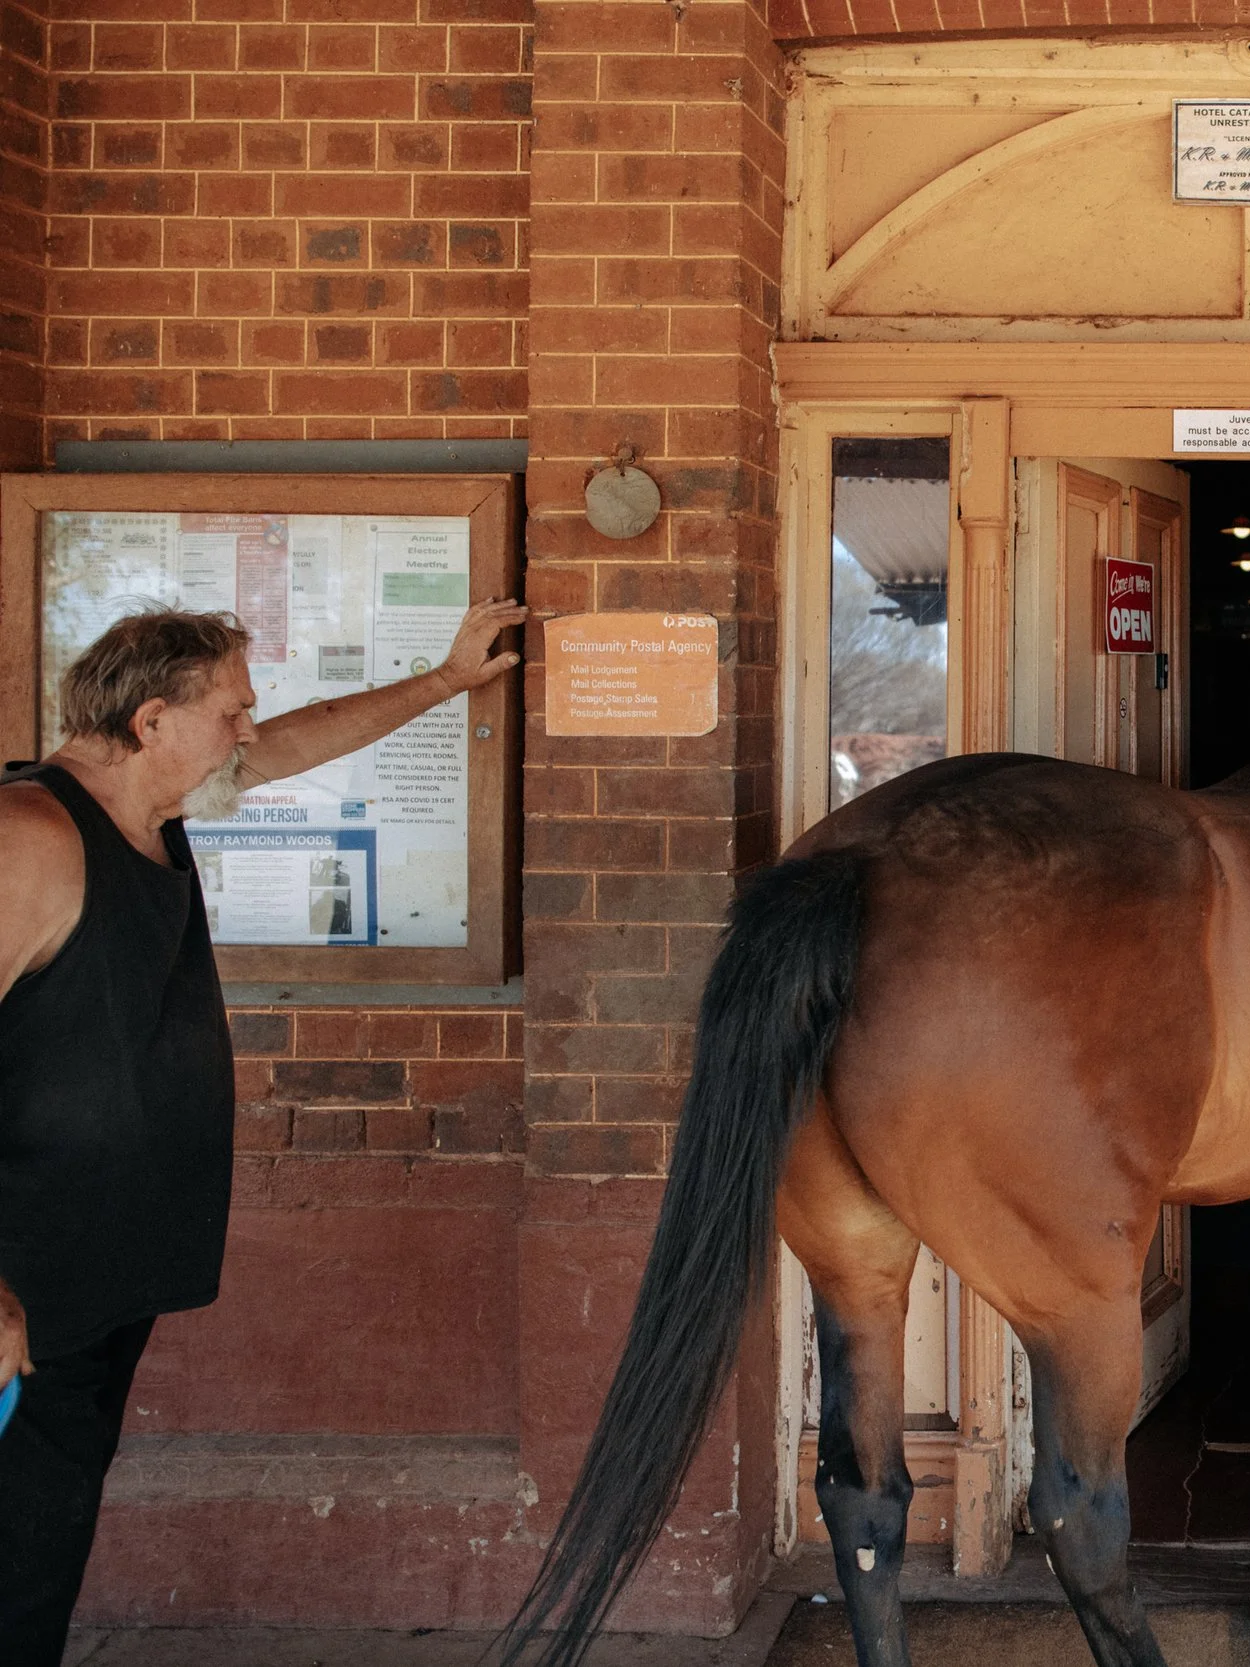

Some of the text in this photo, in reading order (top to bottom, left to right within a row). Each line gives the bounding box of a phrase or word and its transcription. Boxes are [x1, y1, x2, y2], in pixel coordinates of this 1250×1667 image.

[1216, 427, 1228, 435] be
[228, 524, 262, 532] everyone
[406, 561, 448, 569] Meeting
[1110, 606, 1152, 642] OPEN
[561, 639, 712, 655] Community Postal Agency
[570, 665, 638, 675] Mail Lodgement
[571, 680, 637, 688] Mail Collections
[635, 694, 658, 703] Sales
[606, 709, 657, 718] Assessment
[272, 796, 297, 804] APPEAL
[264, 808, 308, 823] PERSON
[190, 835, 332, 845] TROY RAYMOND WOODS
